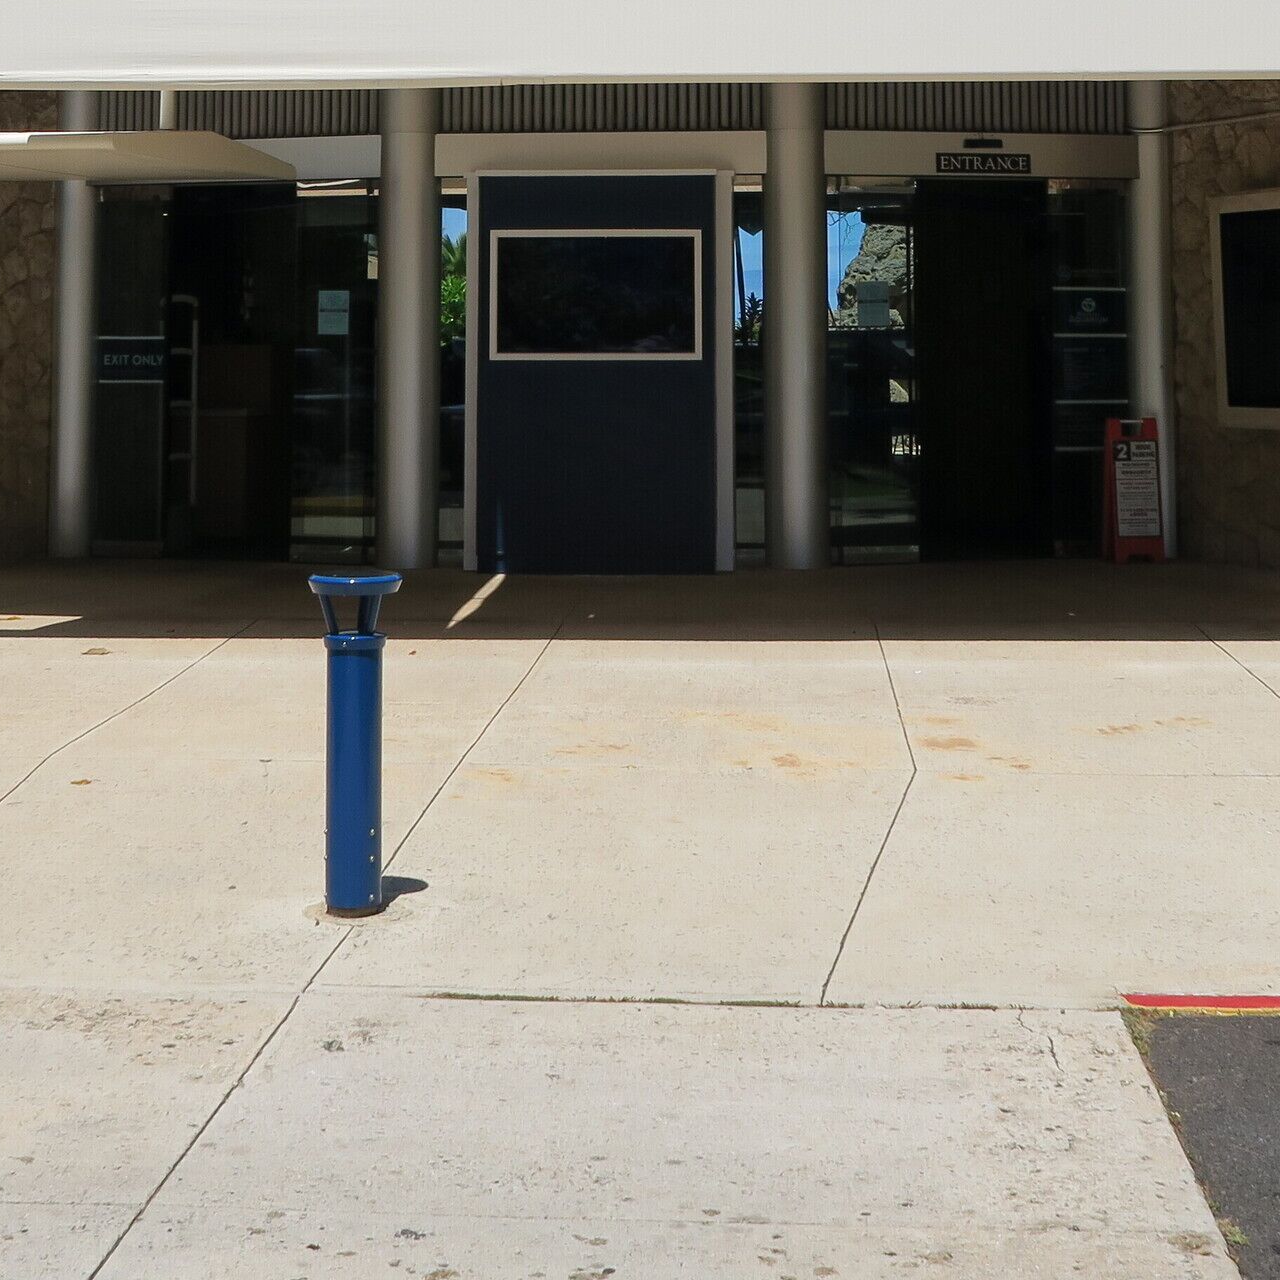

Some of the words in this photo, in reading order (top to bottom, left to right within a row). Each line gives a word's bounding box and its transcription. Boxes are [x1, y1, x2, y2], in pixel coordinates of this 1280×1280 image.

[940, 155, 1028, 171] ENTRANCE
[103, 354, 130, 366] EXIT
[132, 353, 164, 366] ONLY
[1116, 443, 1128, 459] 2
